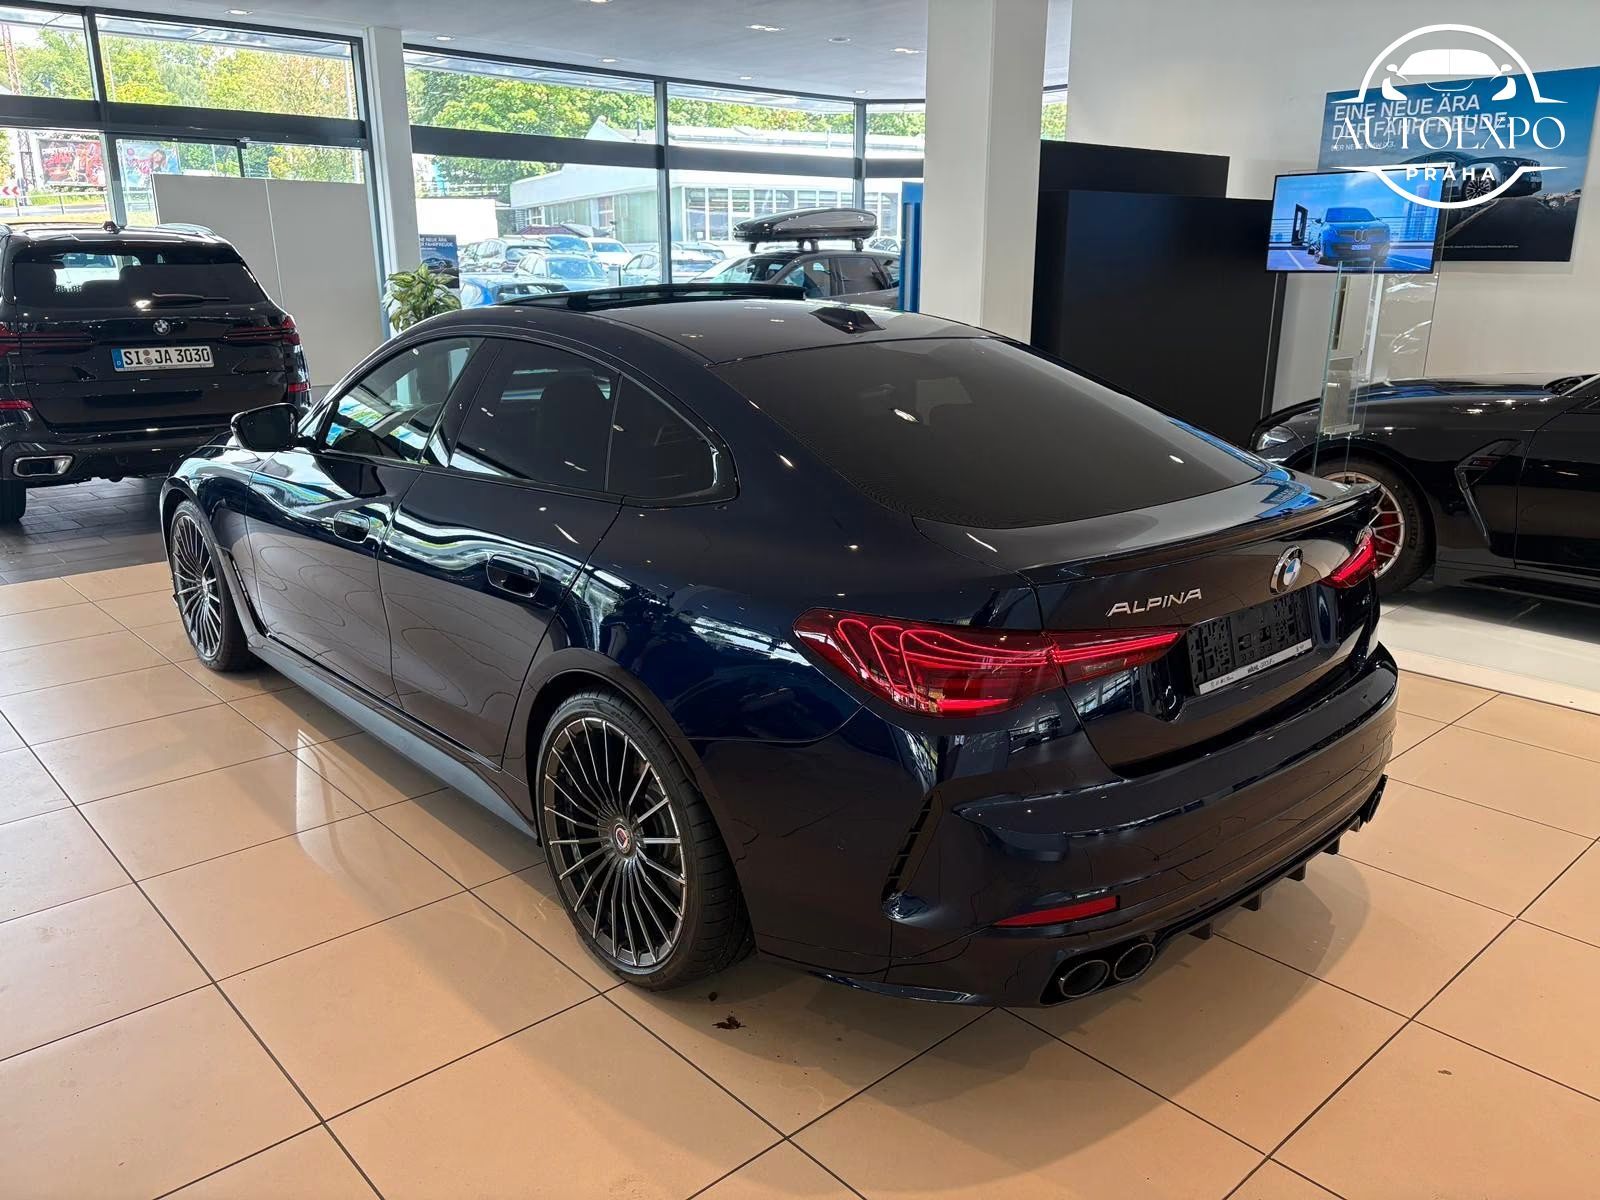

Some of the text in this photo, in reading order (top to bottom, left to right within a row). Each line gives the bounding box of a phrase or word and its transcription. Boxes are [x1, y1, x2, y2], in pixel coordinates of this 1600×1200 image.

[1334, 92, 1480, 121] EINE NEUE ÄRA
[123, 348, 210, 365] SI JA 3030
[1106, 588, 1202, 617] ALPINA
